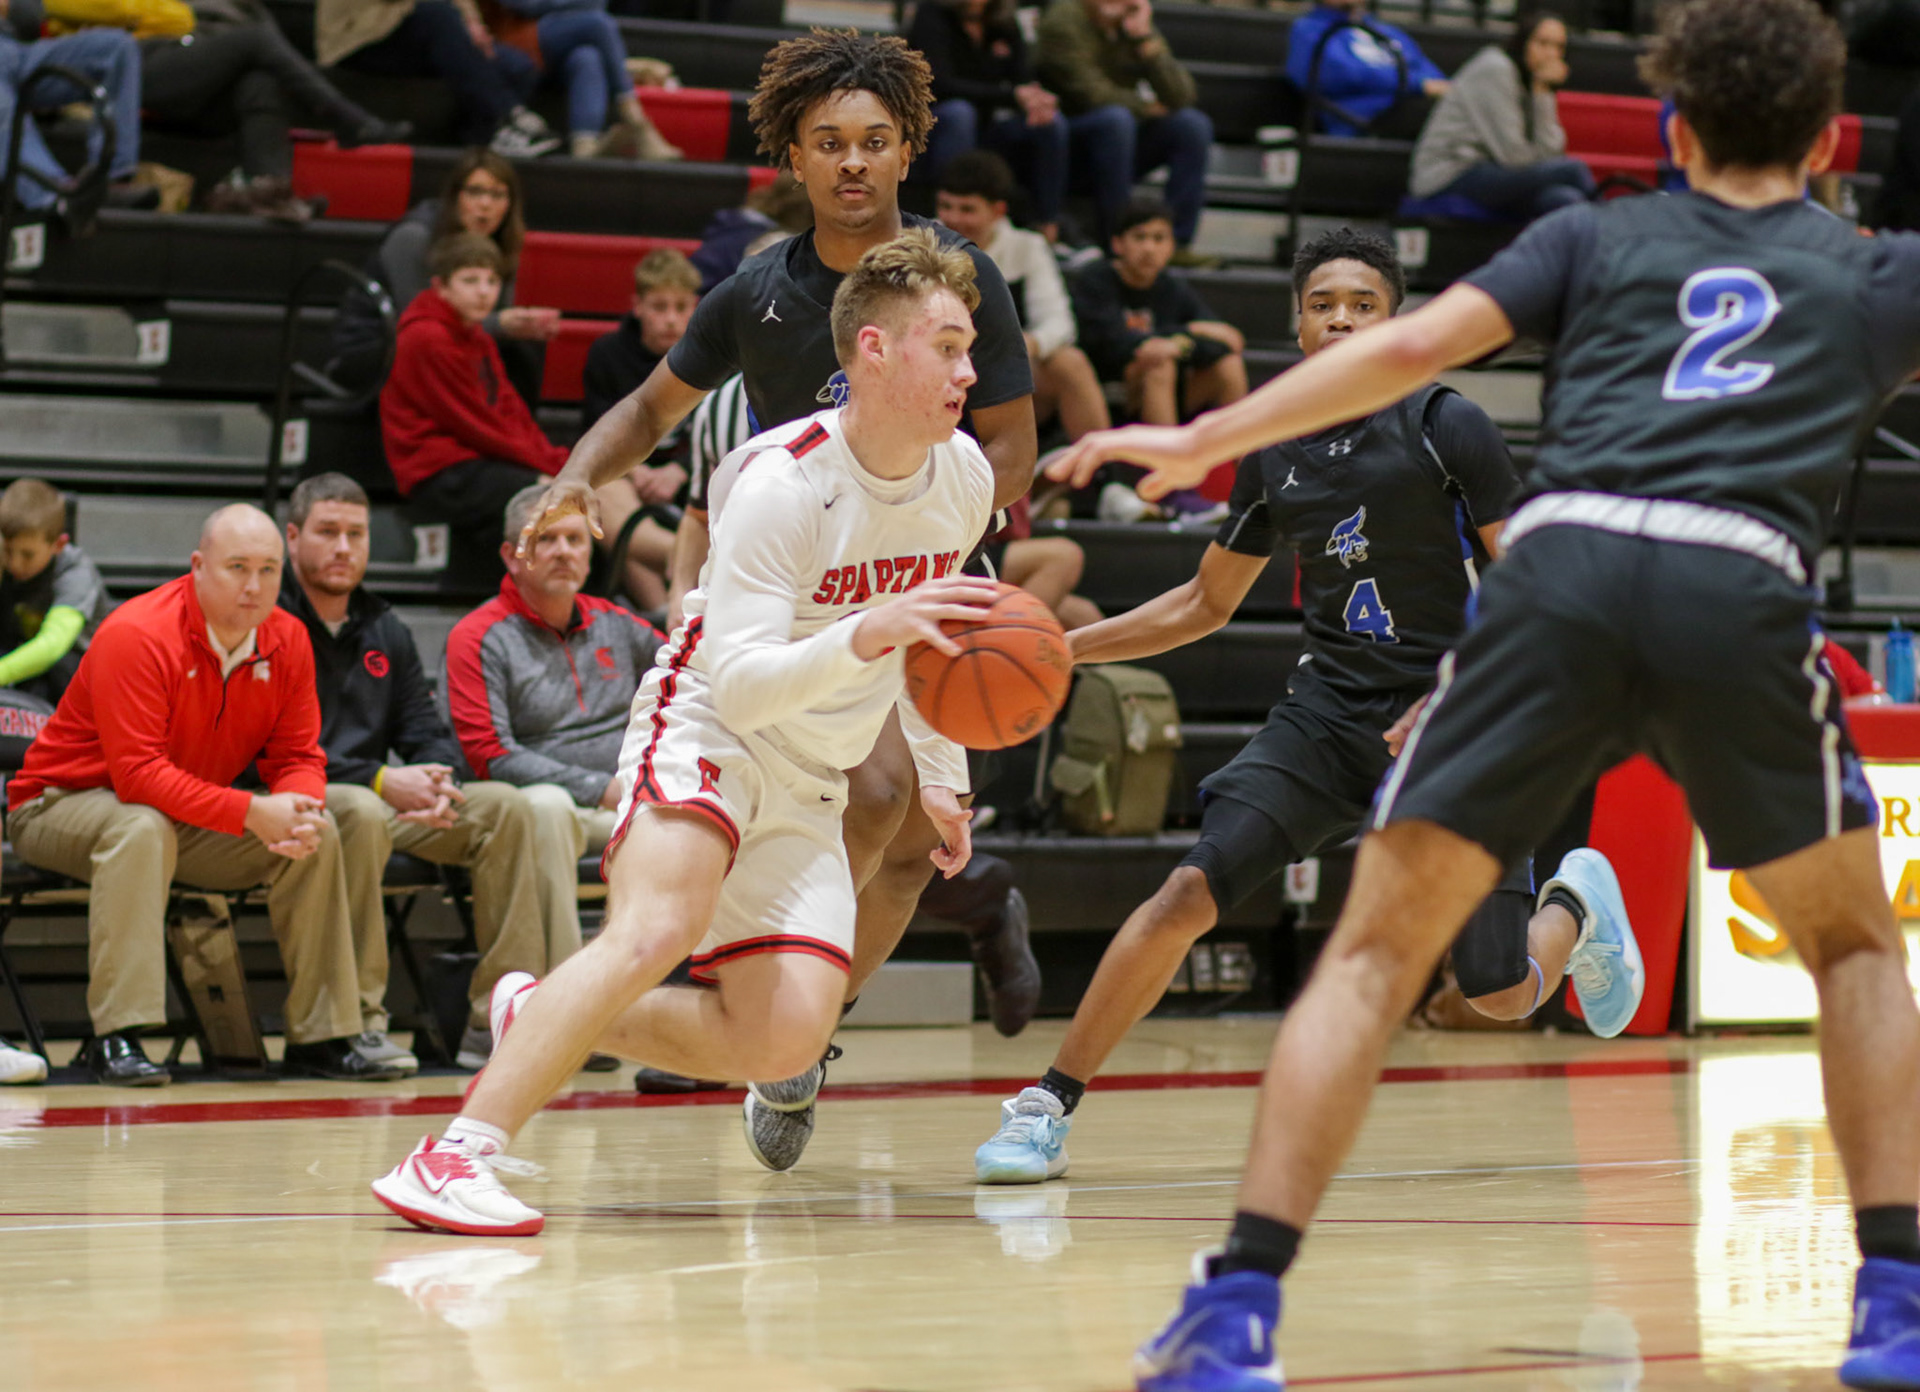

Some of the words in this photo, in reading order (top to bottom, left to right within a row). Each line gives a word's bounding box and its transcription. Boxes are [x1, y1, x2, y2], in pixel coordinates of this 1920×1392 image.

[1662, 267, 1783, 400] 2
[1342, 577, 1401, 643] 4
[1882, 797, 1920, 837] R
